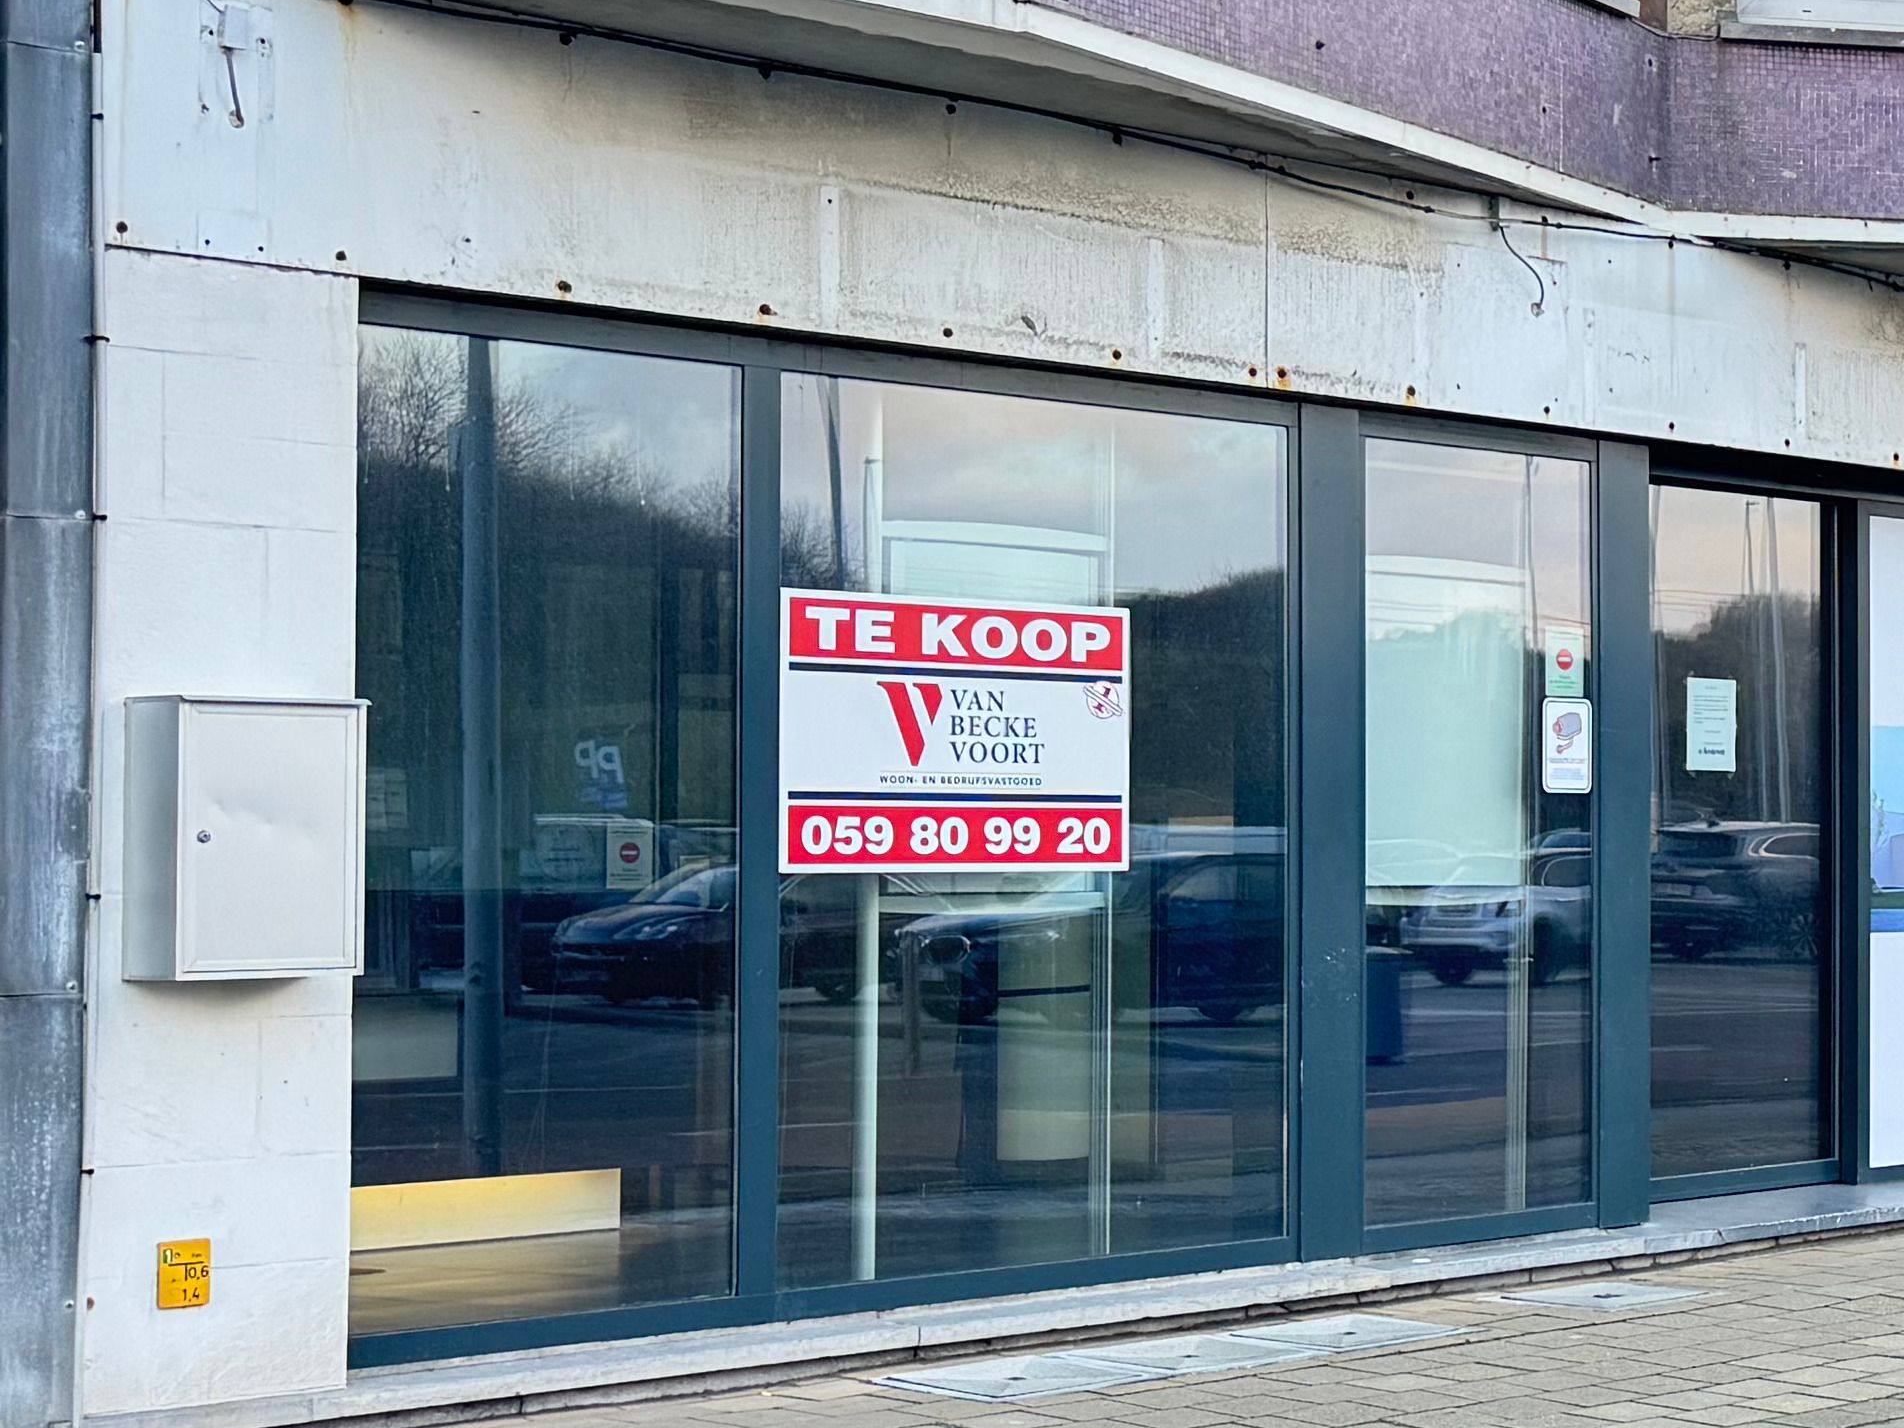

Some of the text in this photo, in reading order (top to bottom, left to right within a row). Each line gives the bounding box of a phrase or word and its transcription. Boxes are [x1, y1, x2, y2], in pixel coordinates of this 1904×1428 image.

[805, 605, 1111, 663] TE KOOP
[950, 688, 1005, 712] VAN
[950, 715, 1038, 739] BECKE
[949, 741, 1046, 765] VOORT
[922, 775, 936, 784] EN
[801, 815, 1111, 856] 059 80 99 20
